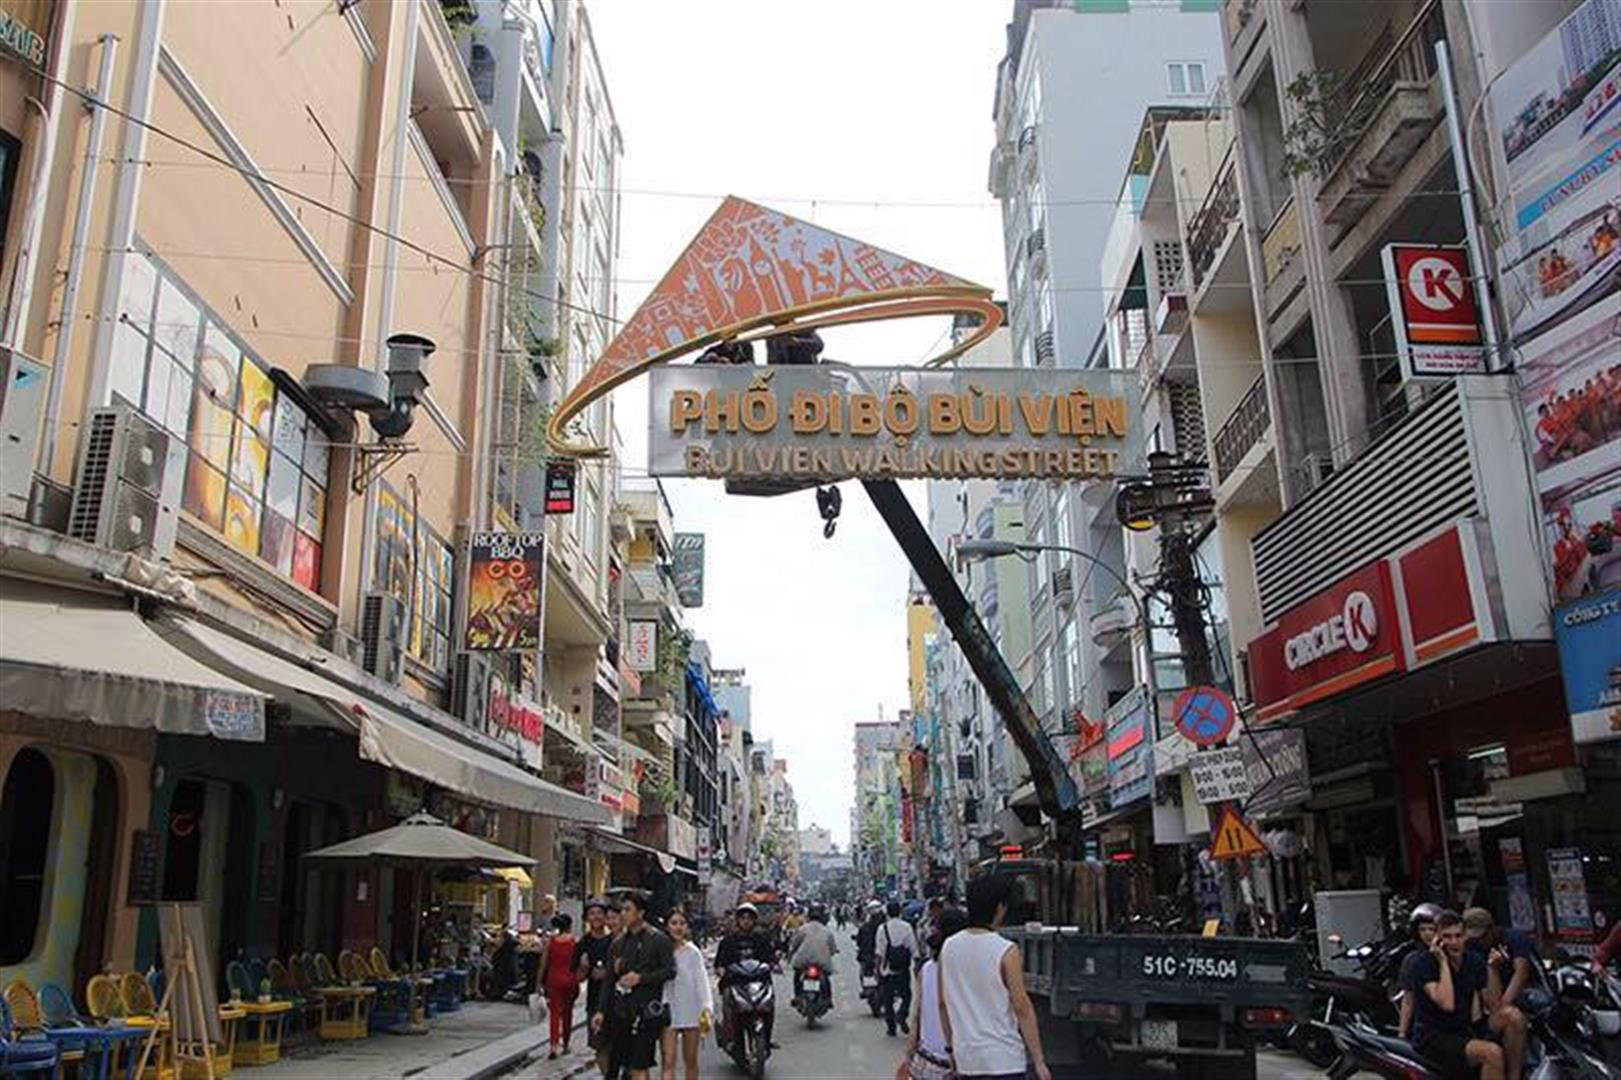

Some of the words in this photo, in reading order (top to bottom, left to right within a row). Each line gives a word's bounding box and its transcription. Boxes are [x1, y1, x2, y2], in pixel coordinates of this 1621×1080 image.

[1419, 264, 1461, 307] K
[670, 371, 779, 434] PHỐ
[789, 389, 843, 436] ĐI
[850, 383, 919, 446] BỘ
[929, 385, 1013, 435] BÙI
[1018, 386, 1127, 446] VIỆN
[686, 444, 745, 474] BUI
[753, 445, 832, 474] VIEN
[843, 446, 997, 475] WALKING
[1002, 448, 1120, 475] STREET
[491, 545, 525, 559] BBQ
[1285, 614, 1346, 670] CIRCLE
[1345, 594, 1377, 650] K
